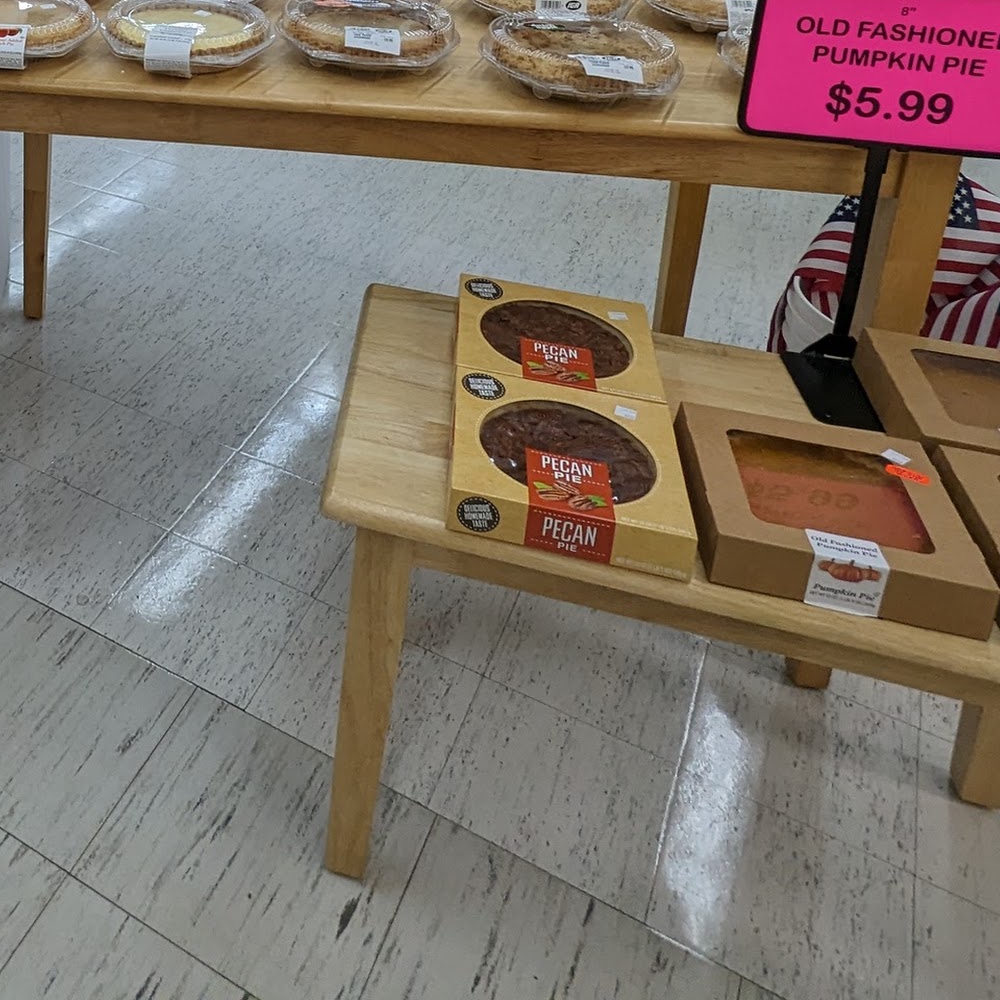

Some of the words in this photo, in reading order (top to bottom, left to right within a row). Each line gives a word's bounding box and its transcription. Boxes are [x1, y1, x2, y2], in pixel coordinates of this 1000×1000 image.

[796, 16, 850, 37] OLD
[812, 45, 936, 72] PUMPKIN
[942, 56, 988, 78] PIE
[825, 80, 954, 125] $5.99
[534, 342, 578, 359] PECAN
[544, 354, 569, 365] PIE
[541, 455, 593, 477] PECAN
[554, 471, 583, 485] PIE
[463, 504, 491, 513] DELICIOUS
[464, 512, 493, 520] HOMEMADE
[472, 519, 488, 528] TASTE
[542, 516, 598, 547] PECAN
[557, 541, 578, 552] PIE
[811, 535, 828, 543] Old
[830, 540, 878, 553] Fashioned
[817, 542, 860, 555] Pumpkin
[862, 550, 878, 558] Pie
[813, 583, 857, 598] Pumpkin
[858, 592, 876, 601] Pie
